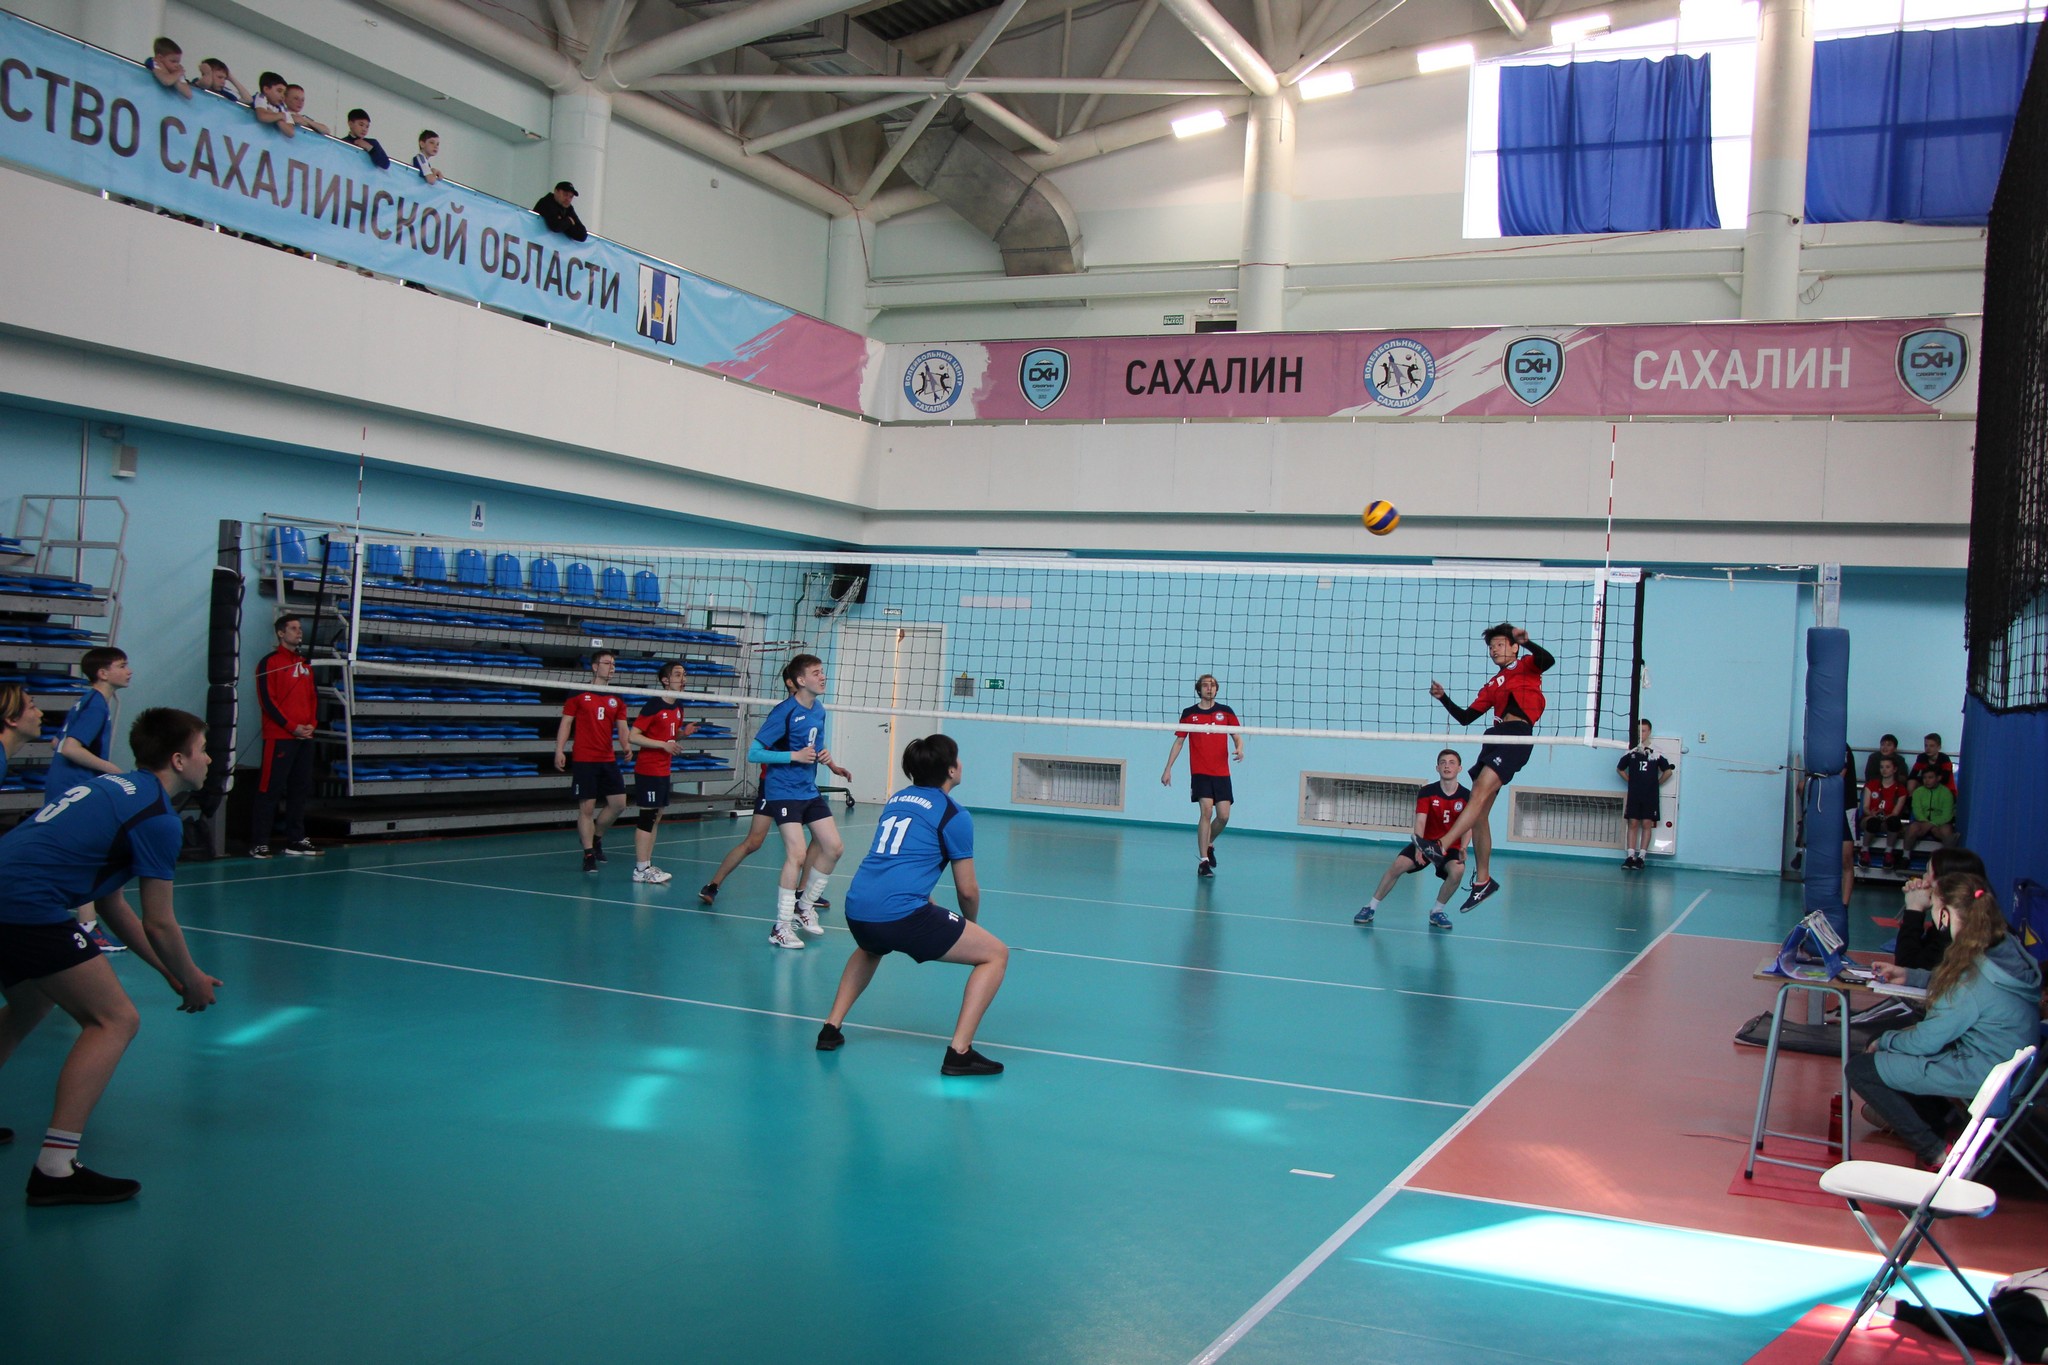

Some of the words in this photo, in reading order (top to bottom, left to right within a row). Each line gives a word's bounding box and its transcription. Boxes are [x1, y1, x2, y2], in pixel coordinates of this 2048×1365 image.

[0, 58, 140, 157] СТВО
[160, 116, 467, 265] САХАЛИНСКОЙ
[480, 227, 620, 313] ОБЛАСТИ
[1365, 340, 1421, 379] ВОЛЕЙБОЛЬНЫЙ
[1421, 350, 1434, 378] ЦЕНТР
[905, 352, 952, 386] ВОЛЕЙБОЛЬНЫЙ
[952, 360, 963, 386] ЦЕНТР
[1126, 356, 1303, 396] САХАЛИН
[1633, 347, 1851, 390] САХАЛИН
[915, 401, 950, 412] САХАЛИН
[1376, 395, 1419, 408] САХАЛИН
[475, 505, 481, 520] А
[597, 707, 605, 720] 8
[808, 727, 818, 747] 9
[1639, 761, 1648, 771] 12
[35, 785, 92, 823] 3
[647, 791, 655, 802] 11
[760, 799, 767, 810] 7
[782, 807, 788, 816] 9
[1443, 810, 1450, 823] 5
[876, 816, 912, 855] 11
[948, 911, 959, 922] 11
[73, 932, 87, 948] 3
